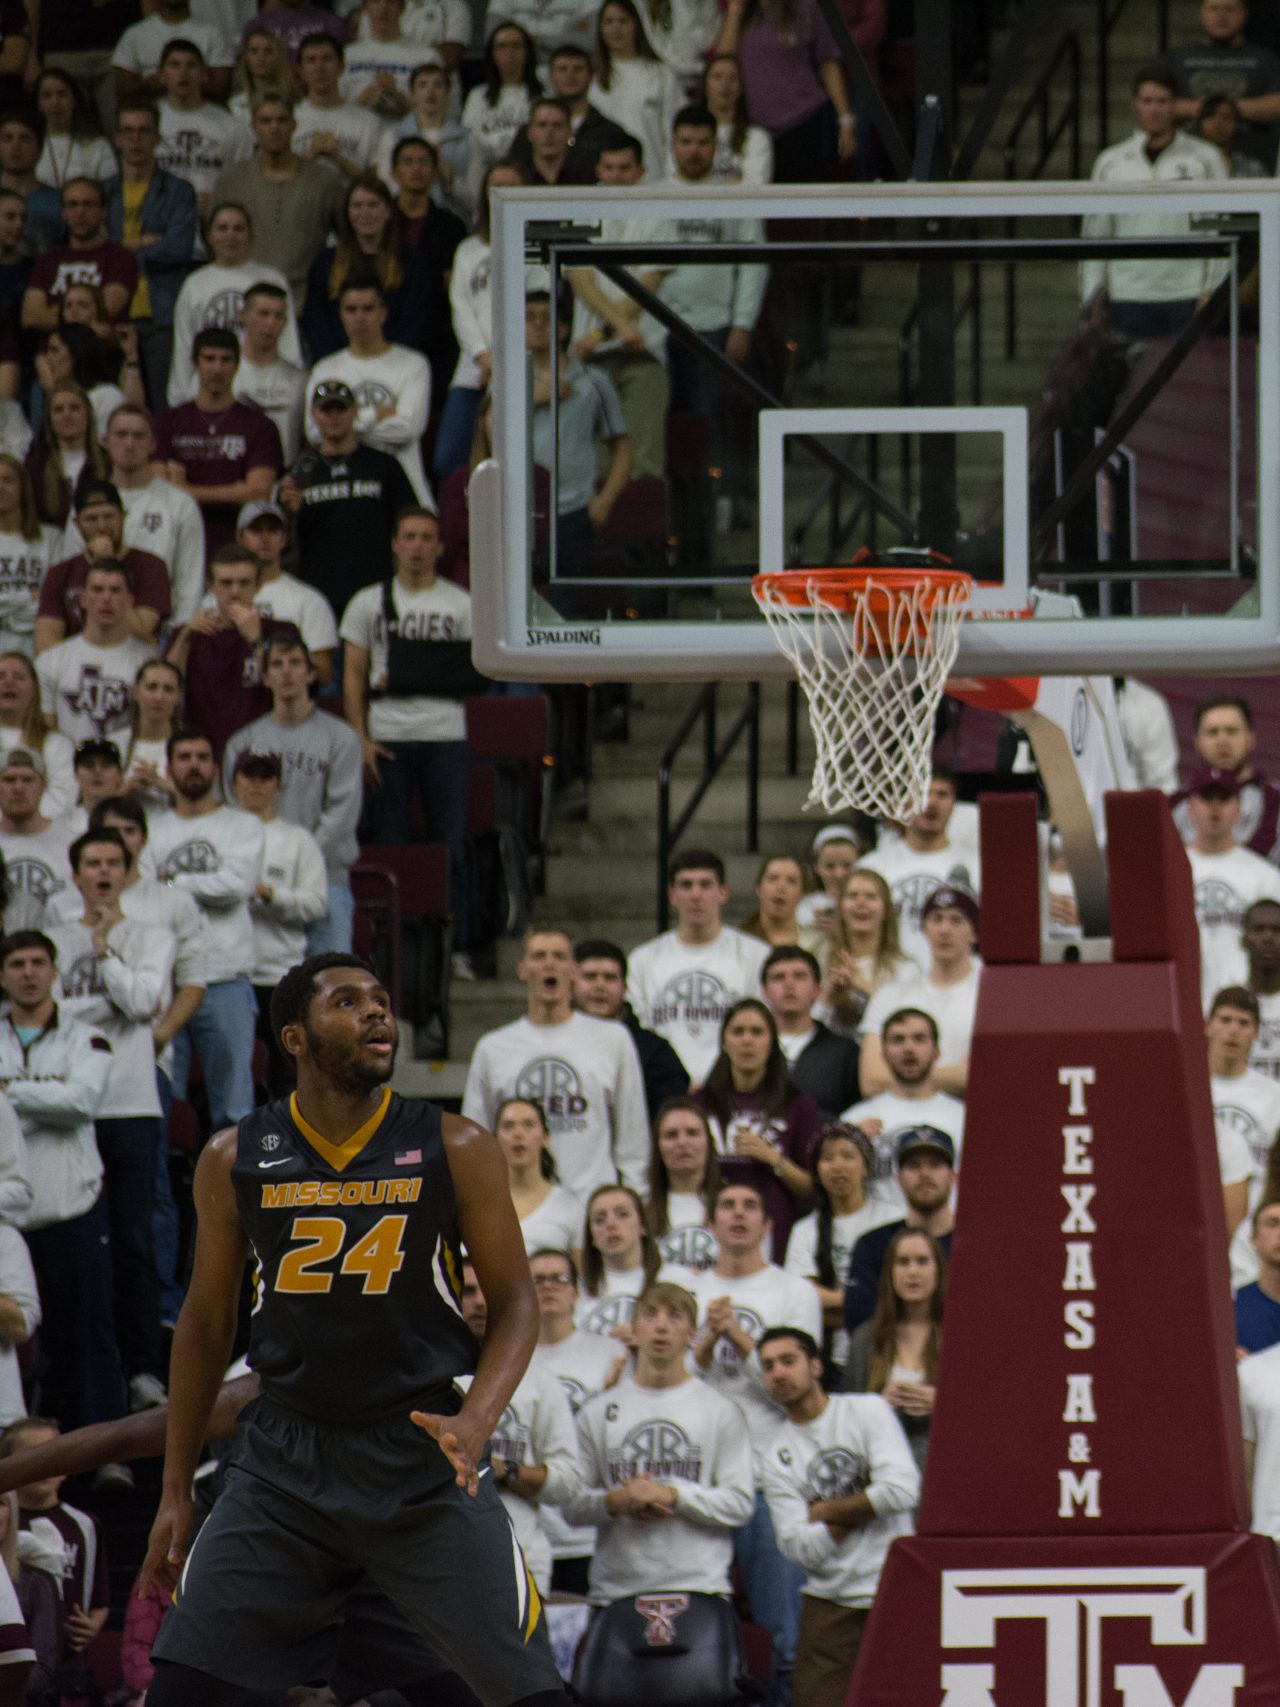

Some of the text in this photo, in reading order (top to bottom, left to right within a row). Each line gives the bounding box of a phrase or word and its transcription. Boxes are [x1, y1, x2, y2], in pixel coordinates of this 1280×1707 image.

[527, 629, 600, 646] SPALDING
[261, 1177, 424, 1209] MISSOURI
[1057, 1066, 1097, 1350] TEXAS
[273, 1214, 409, 1295] 24
